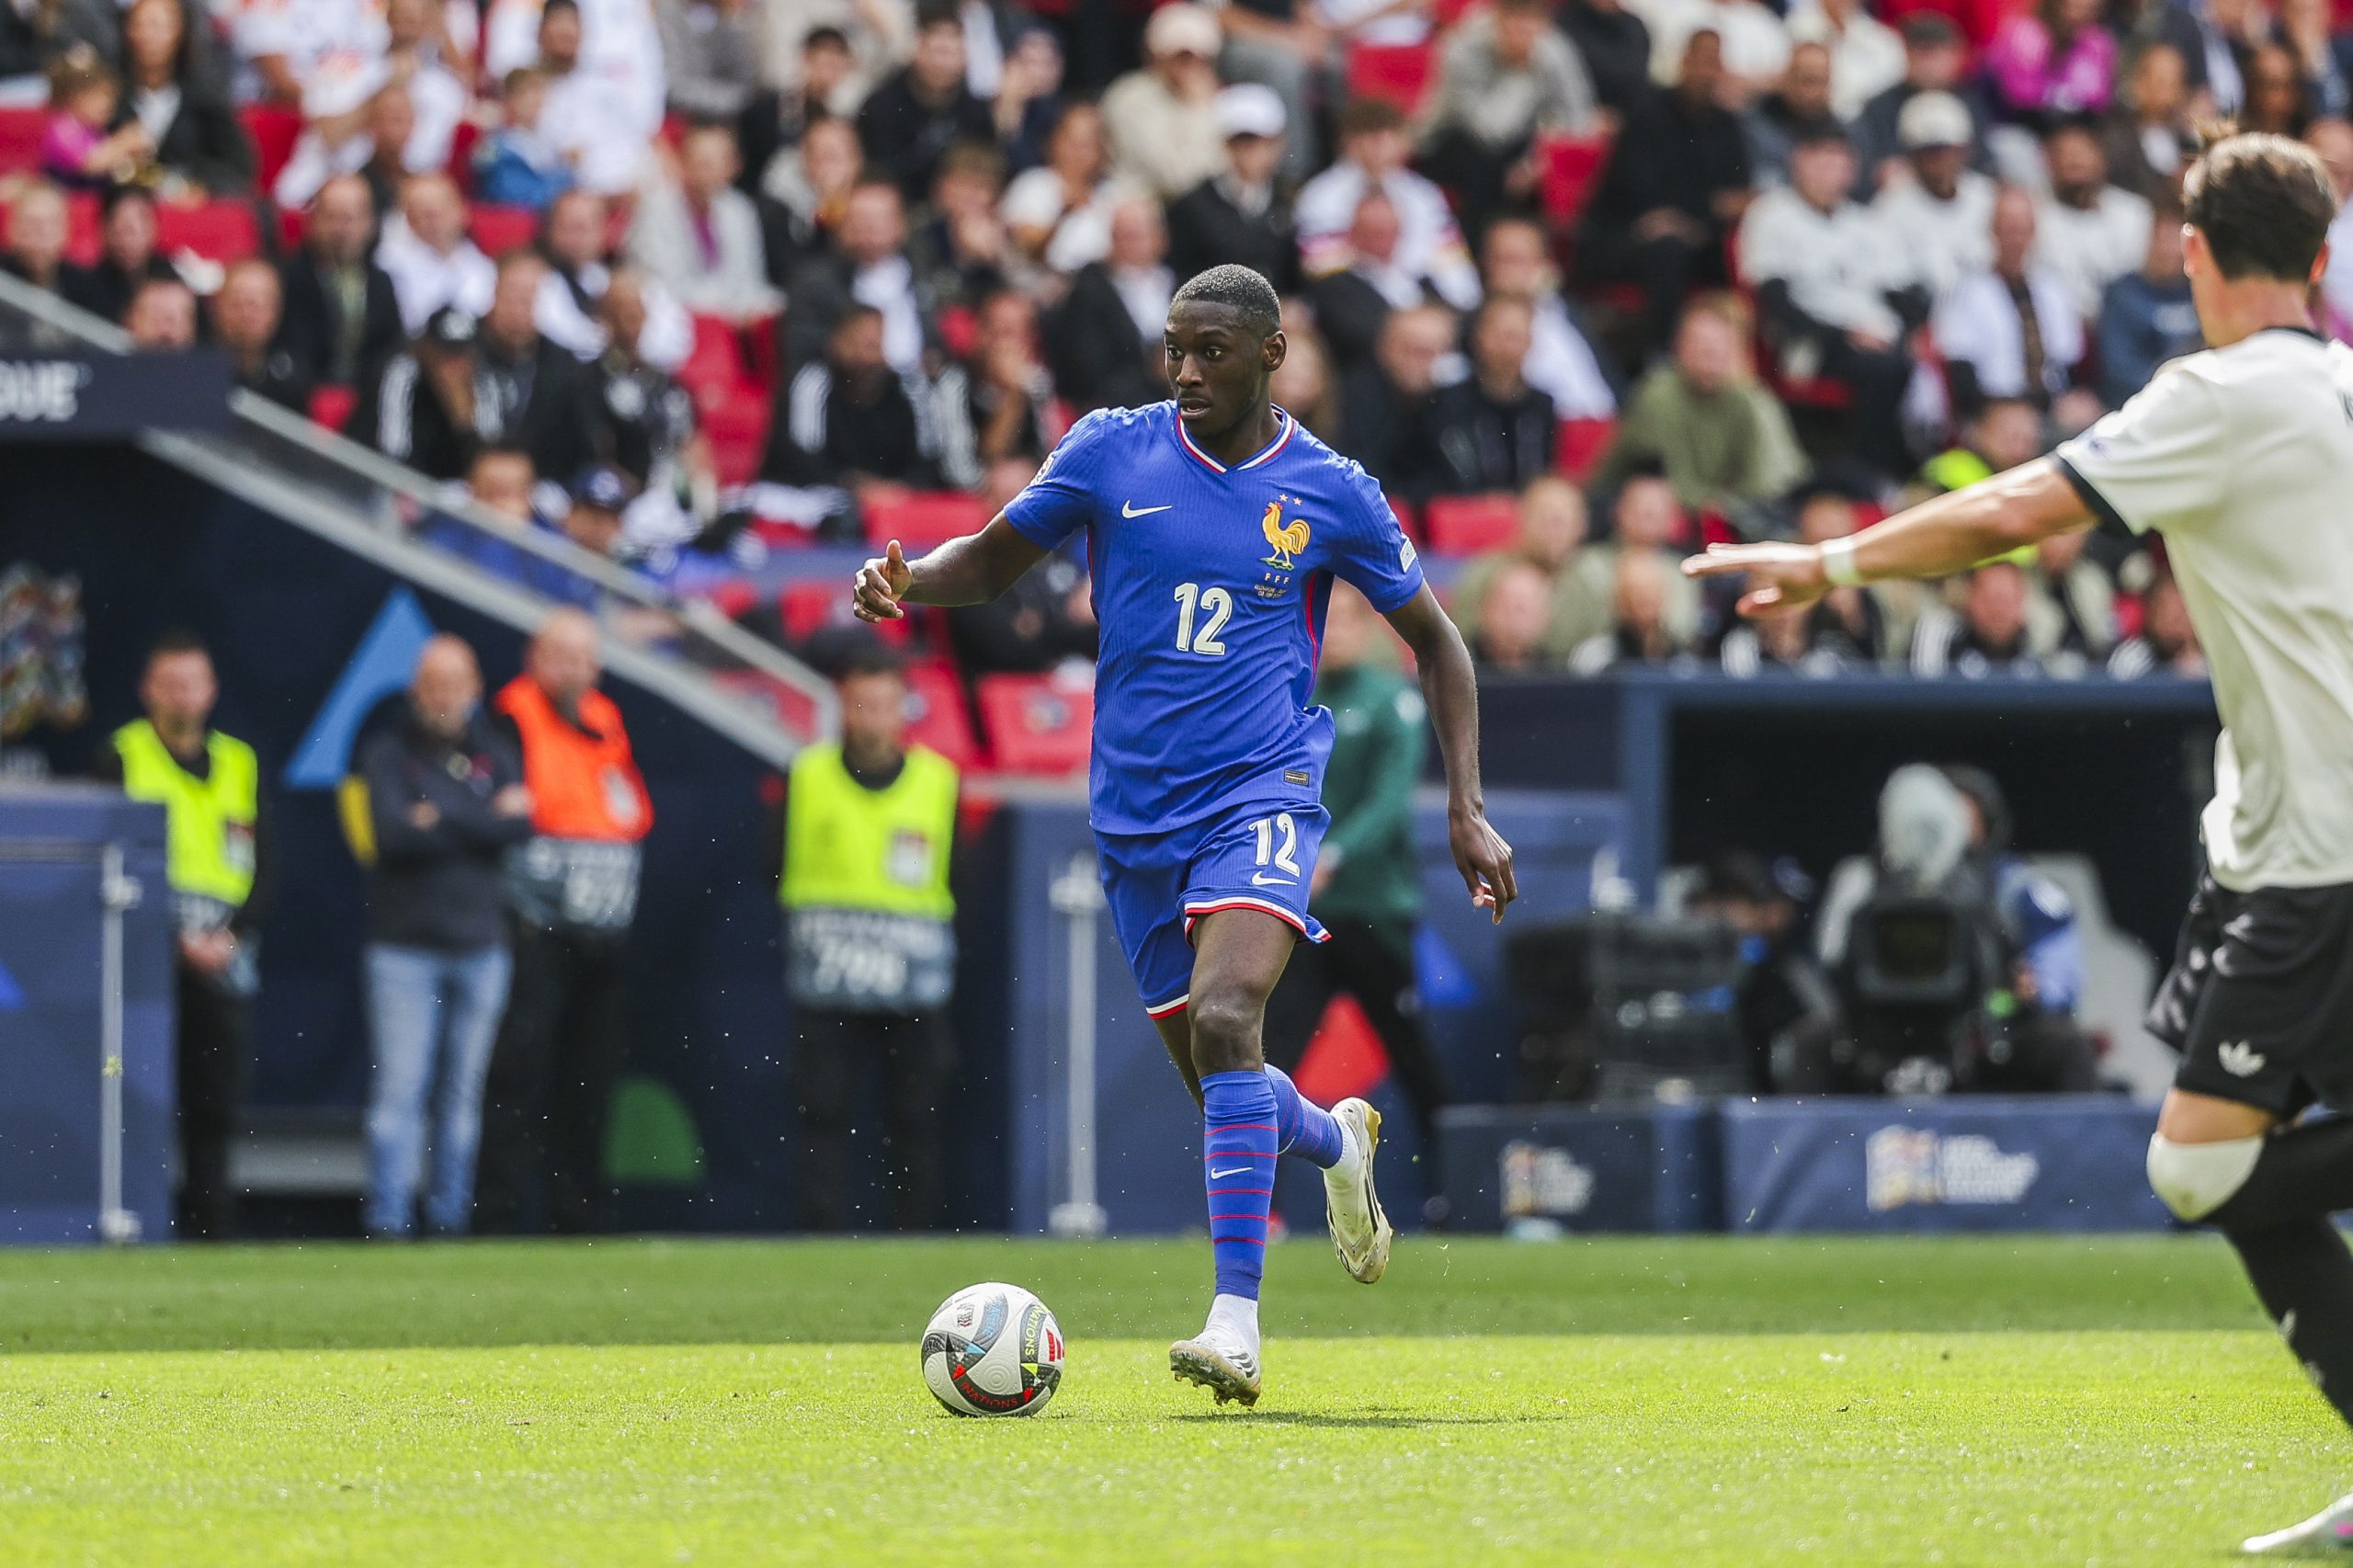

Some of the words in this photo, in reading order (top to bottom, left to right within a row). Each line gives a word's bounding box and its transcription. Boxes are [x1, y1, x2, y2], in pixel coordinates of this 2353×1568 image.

[1174, 582, 1233, 655] 12
[1247, 812, 1301, 878] 12
[1025, 1305, 1049, 1356] NATIONS
